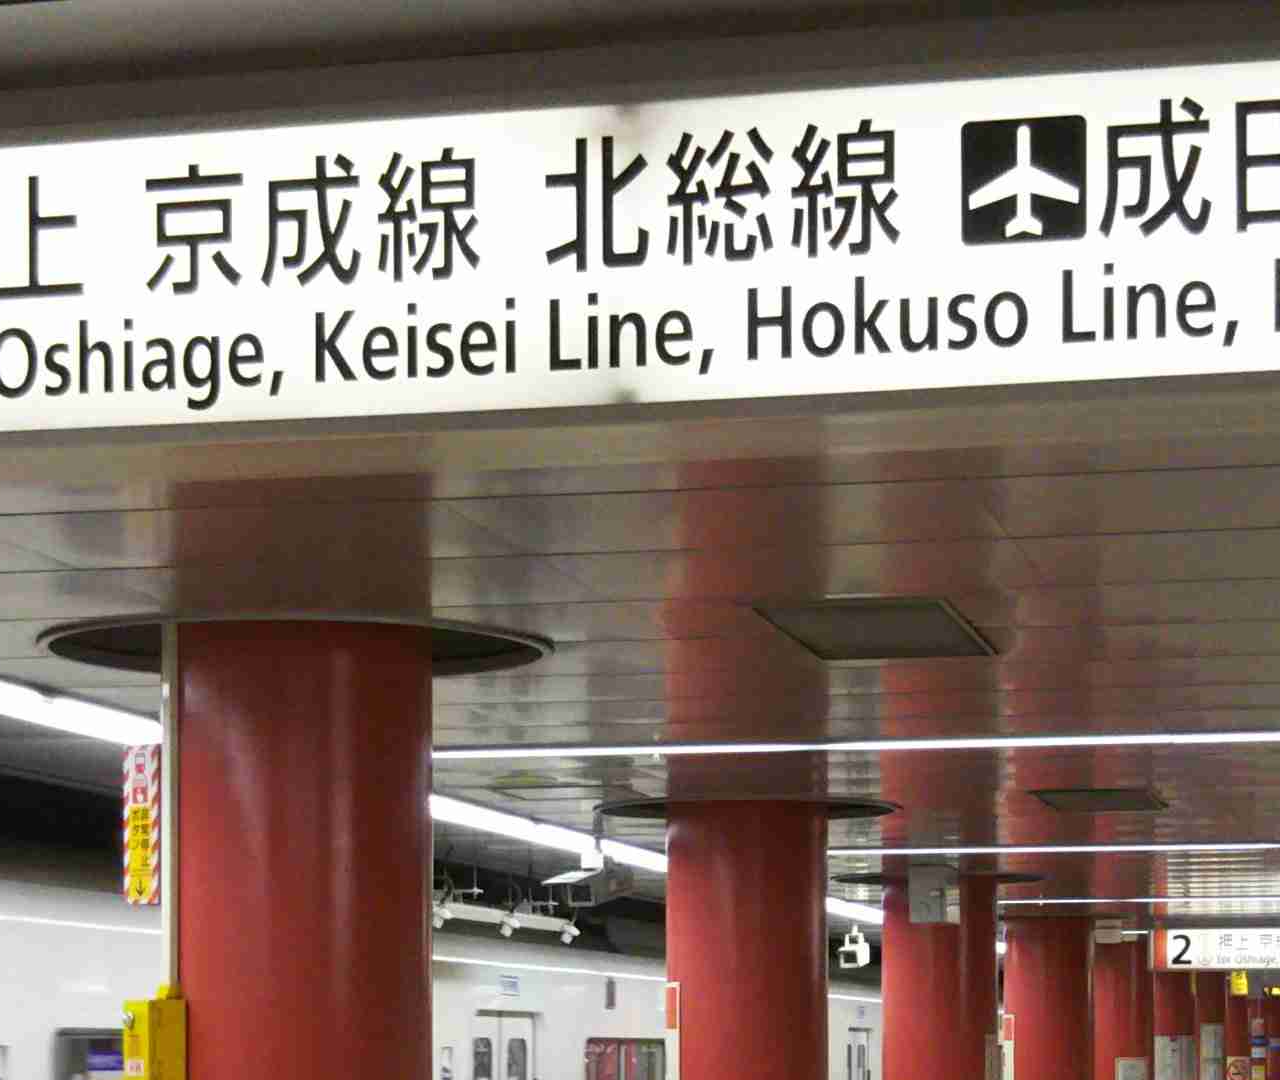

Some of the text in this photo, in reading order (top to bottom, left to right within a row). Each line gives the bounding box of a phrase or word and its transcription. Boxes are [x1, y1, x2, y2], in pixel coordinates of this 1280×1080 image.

[144, 146, 480, 295] 京成線
[544, 118, 901, 273] 北総線
[314, 297, 517, 383] Keisei
[548, 292, 715, 376] Line,
[746, 276, 1029, 362] Hokuso
[1061, 262, 1239, 347] Line,
[1172, 934, 1193, 965] 2
